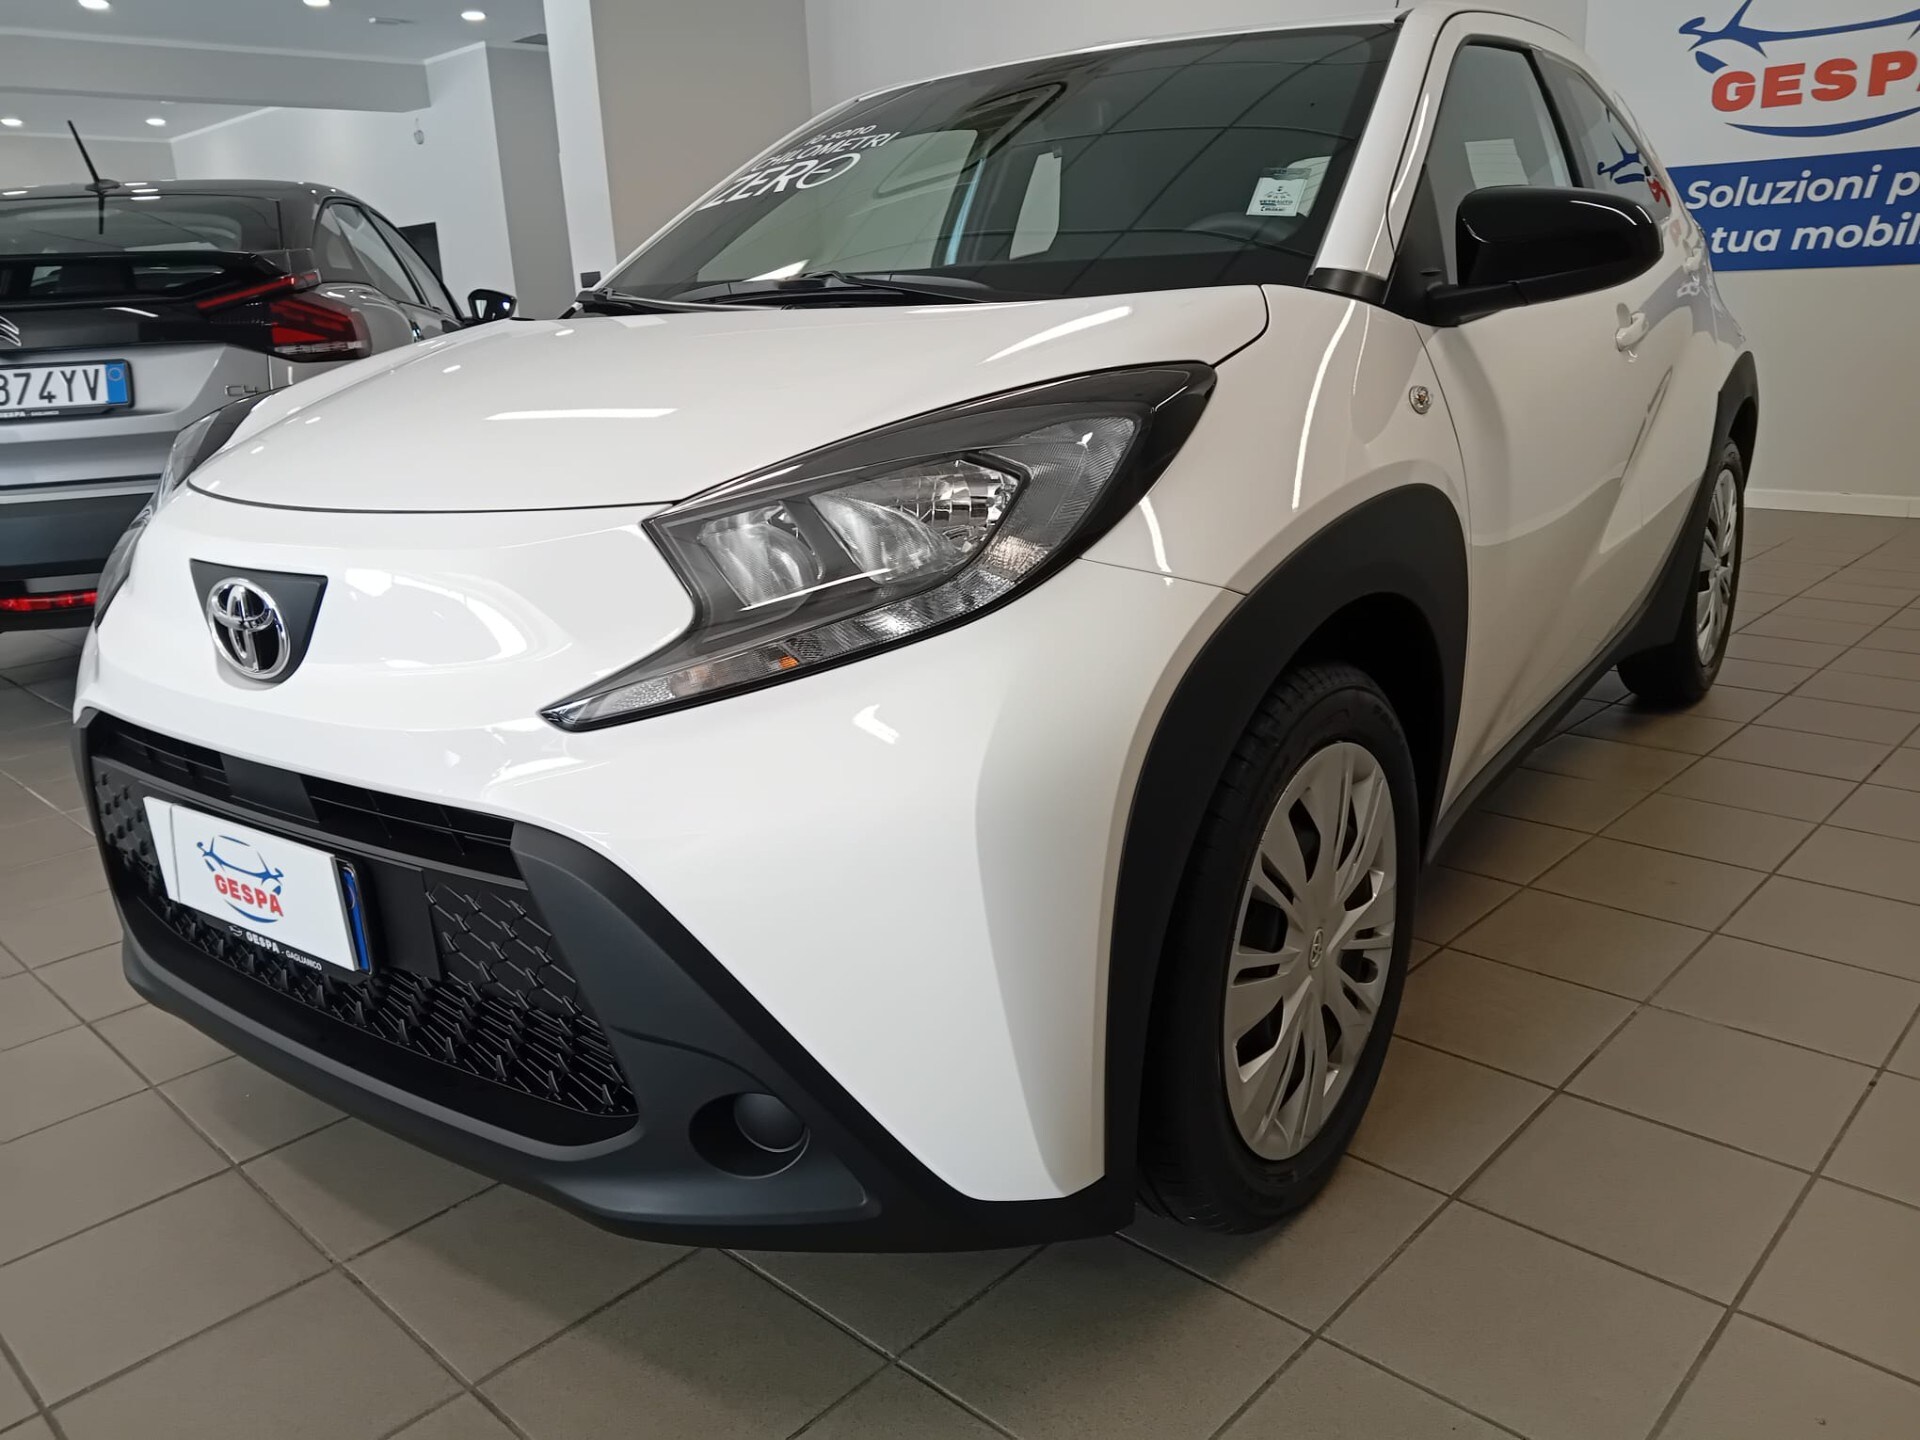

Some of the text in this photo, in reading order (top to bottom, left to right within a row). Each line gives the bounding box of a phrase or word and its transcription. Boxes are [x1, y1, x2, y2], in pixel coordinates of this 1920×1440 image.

[1711, 50, 1920, 112] GESP
[825, 124, 878, 141] sono
[697, 152, 862, 212] ZERO
[1684, 163, 1883, 210] Soluzioni
[1710, 226, 1781, 254] tua
[214, 873, 284, 918] GESPA
[245, 931, 280, 954] GESPA
